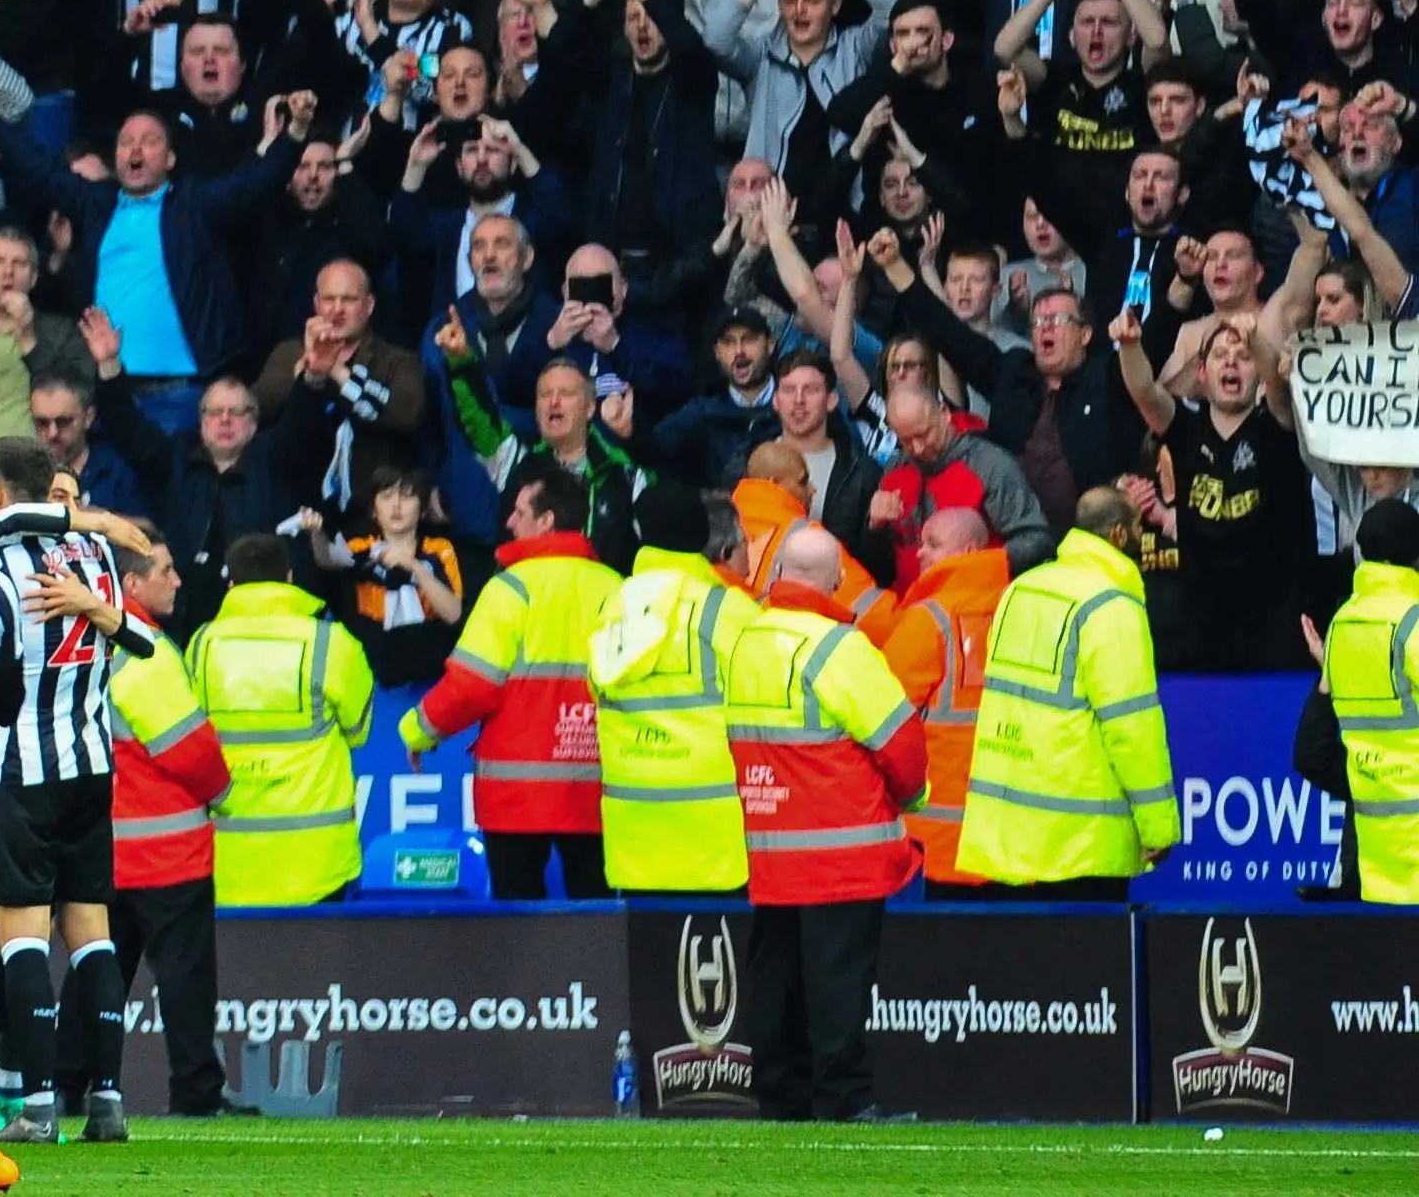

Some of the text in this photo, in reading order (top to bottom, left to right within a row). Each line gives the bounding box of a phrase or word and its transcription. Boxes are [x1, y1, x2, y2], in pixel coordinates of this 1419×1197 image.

[1297, 347, 1408, 389] CAN I
[1183, 860, 1331, 881] KING OF DUTY
[659, 1053, 753, 1091] HungryHors
[1177, 1058, 1286, 1097] HungryHorse
